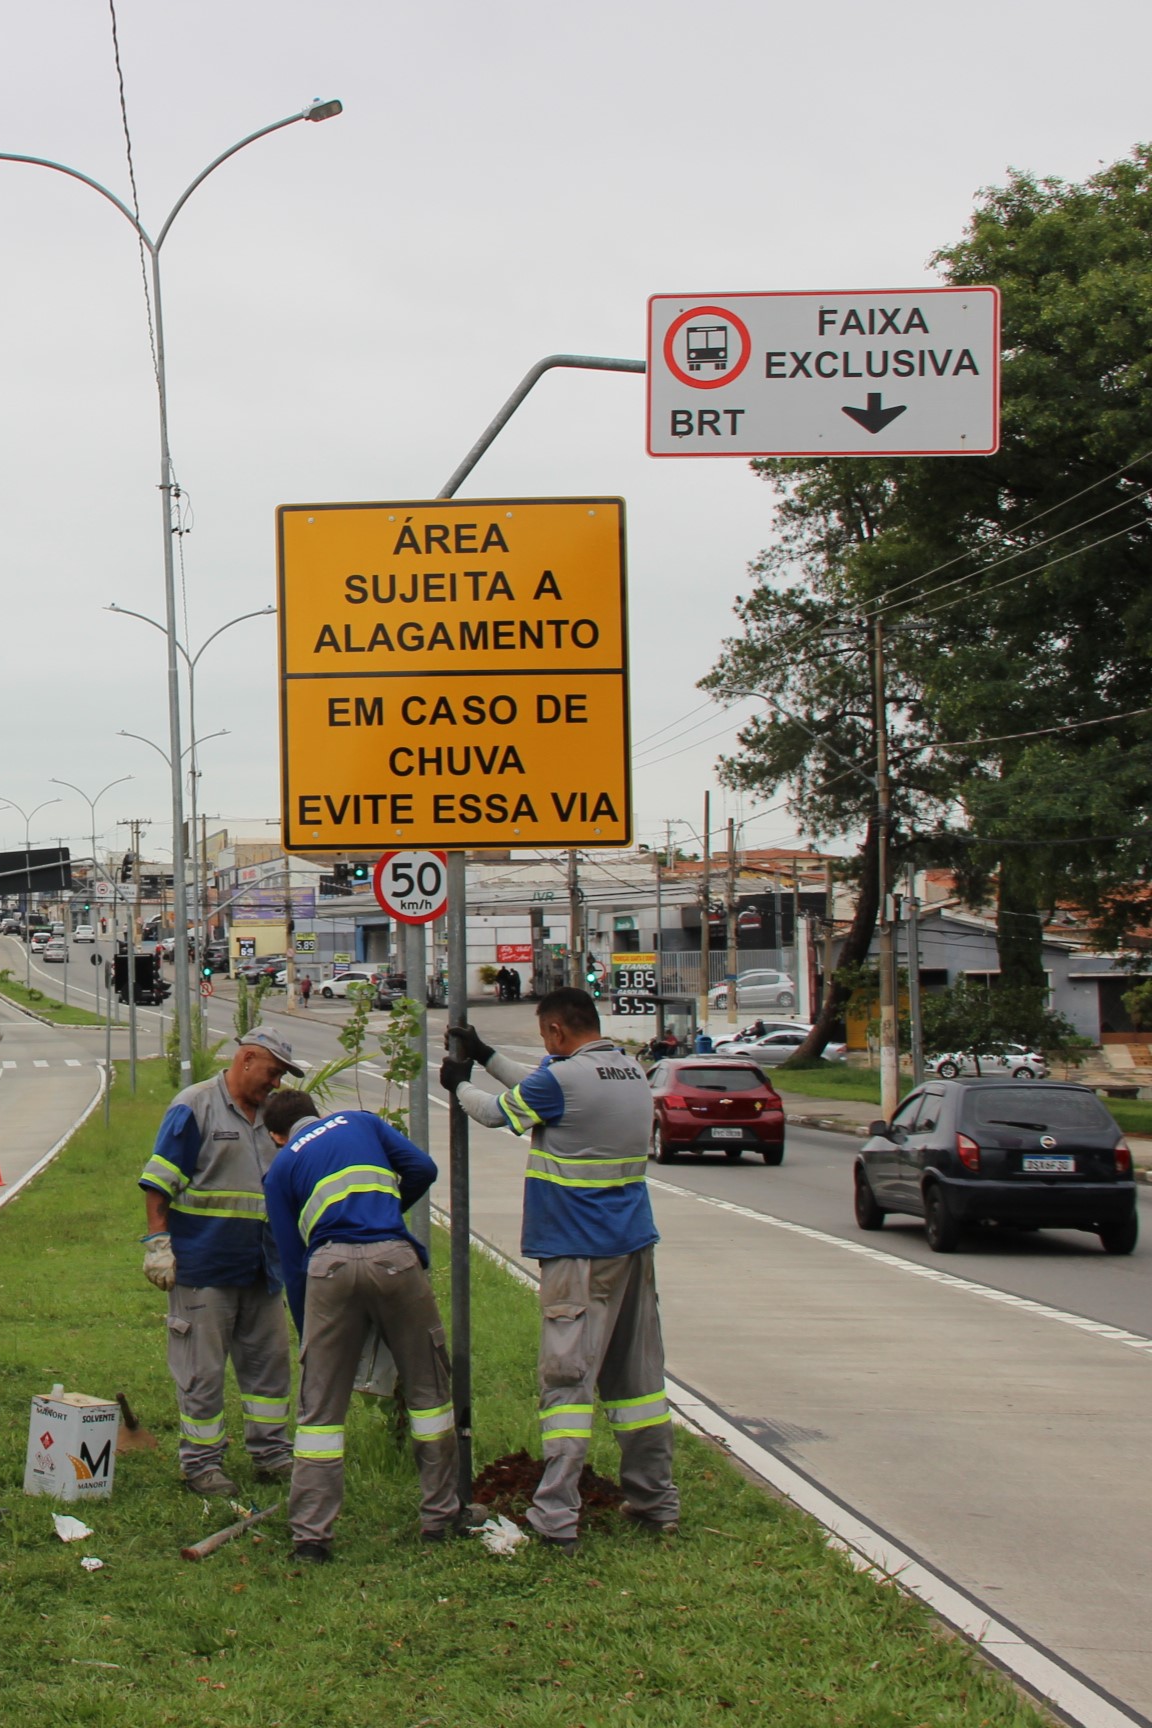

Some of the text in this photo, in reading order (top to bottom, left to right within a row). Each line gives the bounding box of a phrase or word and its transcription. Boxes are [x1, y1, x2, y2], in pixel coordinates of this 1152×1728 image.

[818, 308, 930, 336] FAIXA
[765, 348, 980, 379] EXCLUSIVA
[670, 409, 746, 437] BRT
[393, 516, 510, 555] ÁREA
[344, 570, 563, 604] SUJEITA A
[313, 618, 599, 653] ALAGAMENTO
[328, 694, 588, 727] EM CASO DE
[388, 745, 526, 777] CHUVA
[298, 792, 619, 826] EVITE ESSA VIA
[391, 862, 442, 898] 50
[400, 899, 432, 910] km/h
[530, 891, 554, 902] JVR
[619, 971, 656, 988] 3,85
[596, 1066, 642, 1081] EMDEC
[290, 1114, 349, 1153] EMDEC
[35, 1406, 68, 1422] MANORT
[81, 1413, 116, 1424] SOLVENTE
[77, 1480, 108, 1490] MANORT
